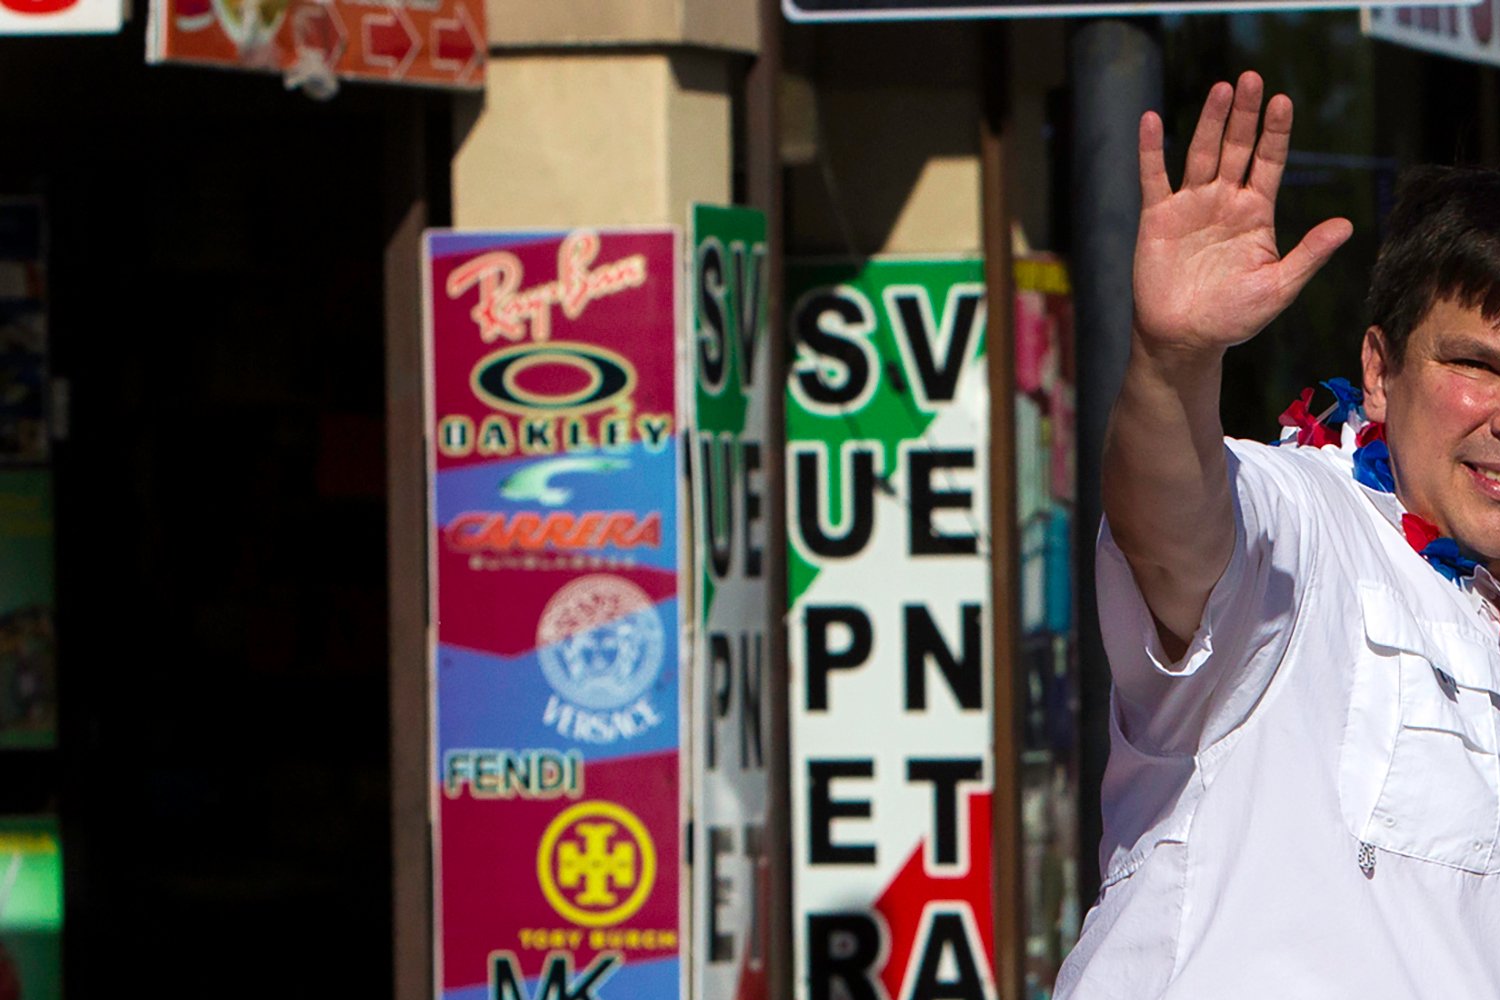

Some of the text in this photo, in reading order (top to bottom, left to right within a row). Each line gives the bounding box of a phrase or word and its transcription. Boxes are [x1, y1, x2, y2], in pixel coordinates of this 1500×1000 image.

[440, 416, 669, 455] OAKLEY
[445, 512, 661, 548] CARRERA
[446, 750, 582, 797] FENDI
